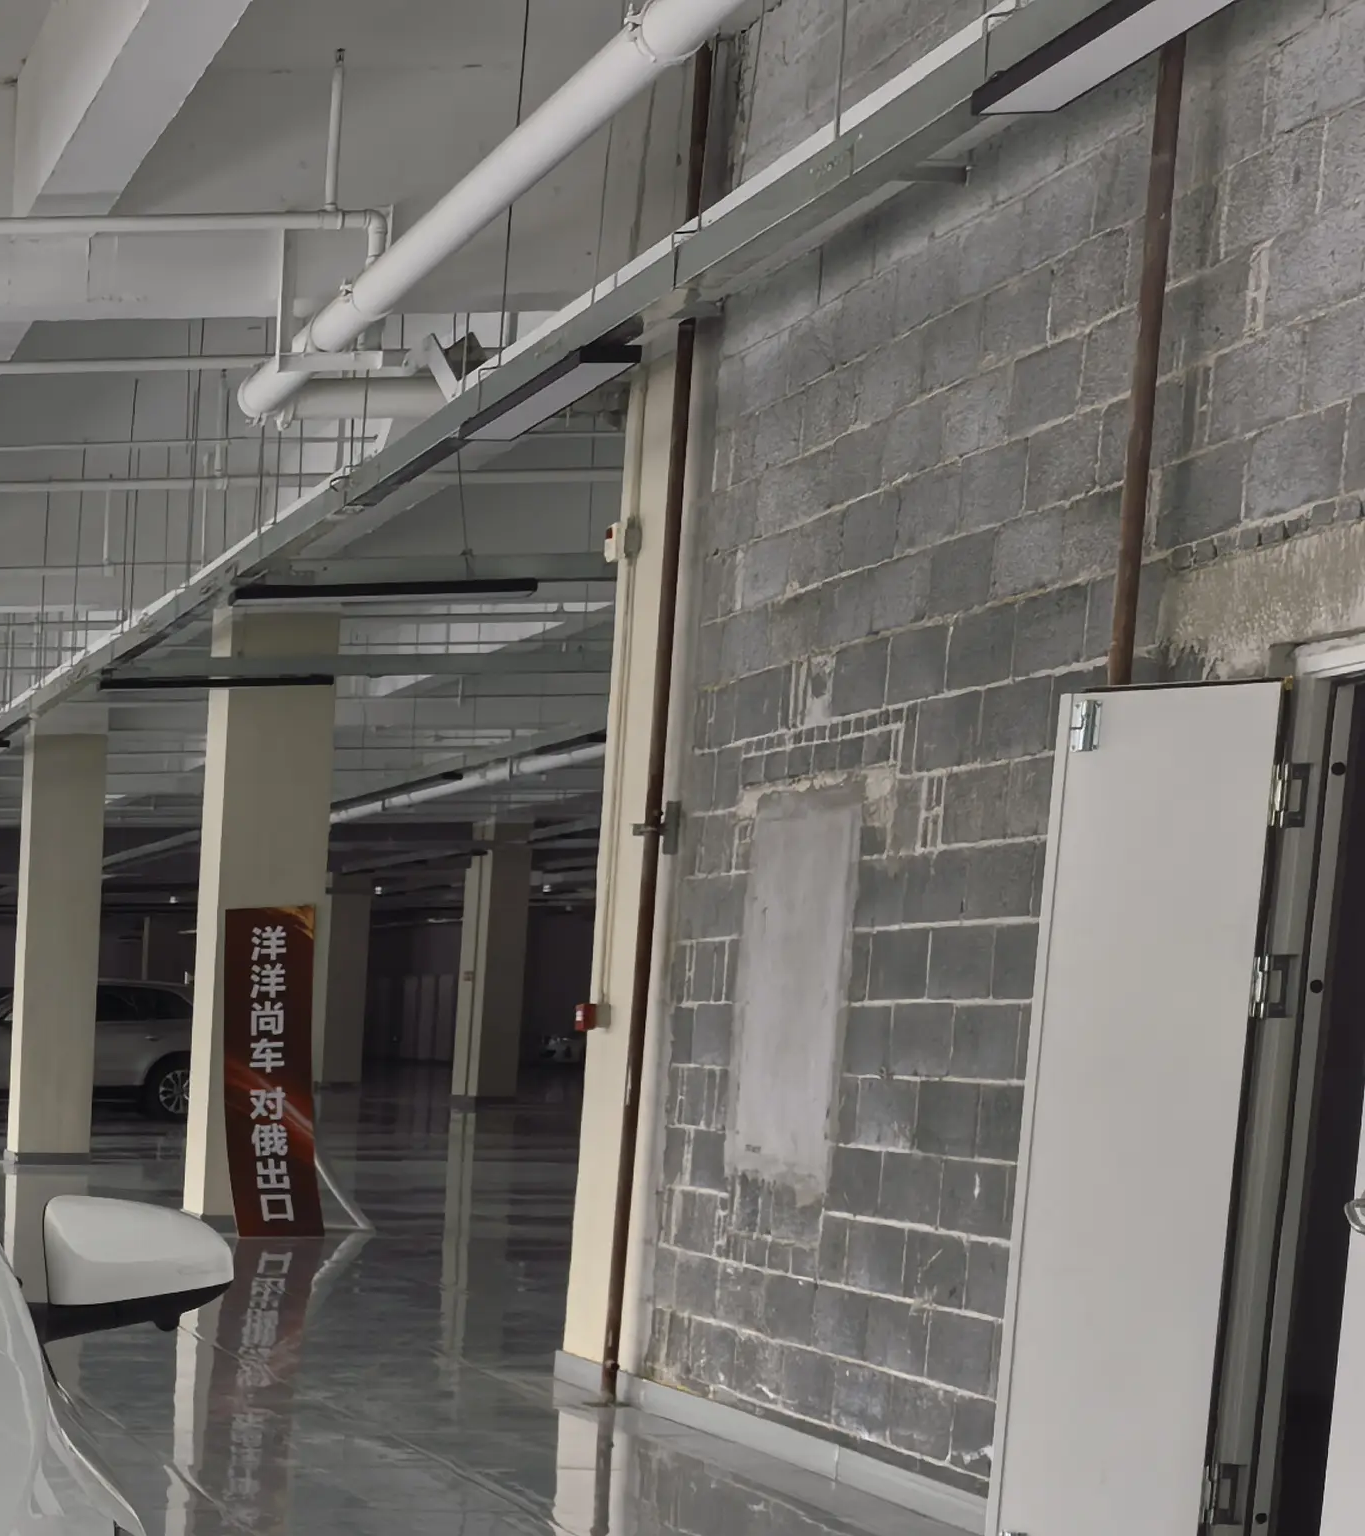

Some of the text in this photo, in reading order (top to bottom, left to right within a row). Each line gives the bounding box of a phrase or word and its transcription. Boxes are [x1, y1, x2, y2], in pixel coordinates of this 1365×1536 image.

[249, 925, 287, 1073] 洋洋尚车
[249, 1086, 295, 1222] 对俄出口
